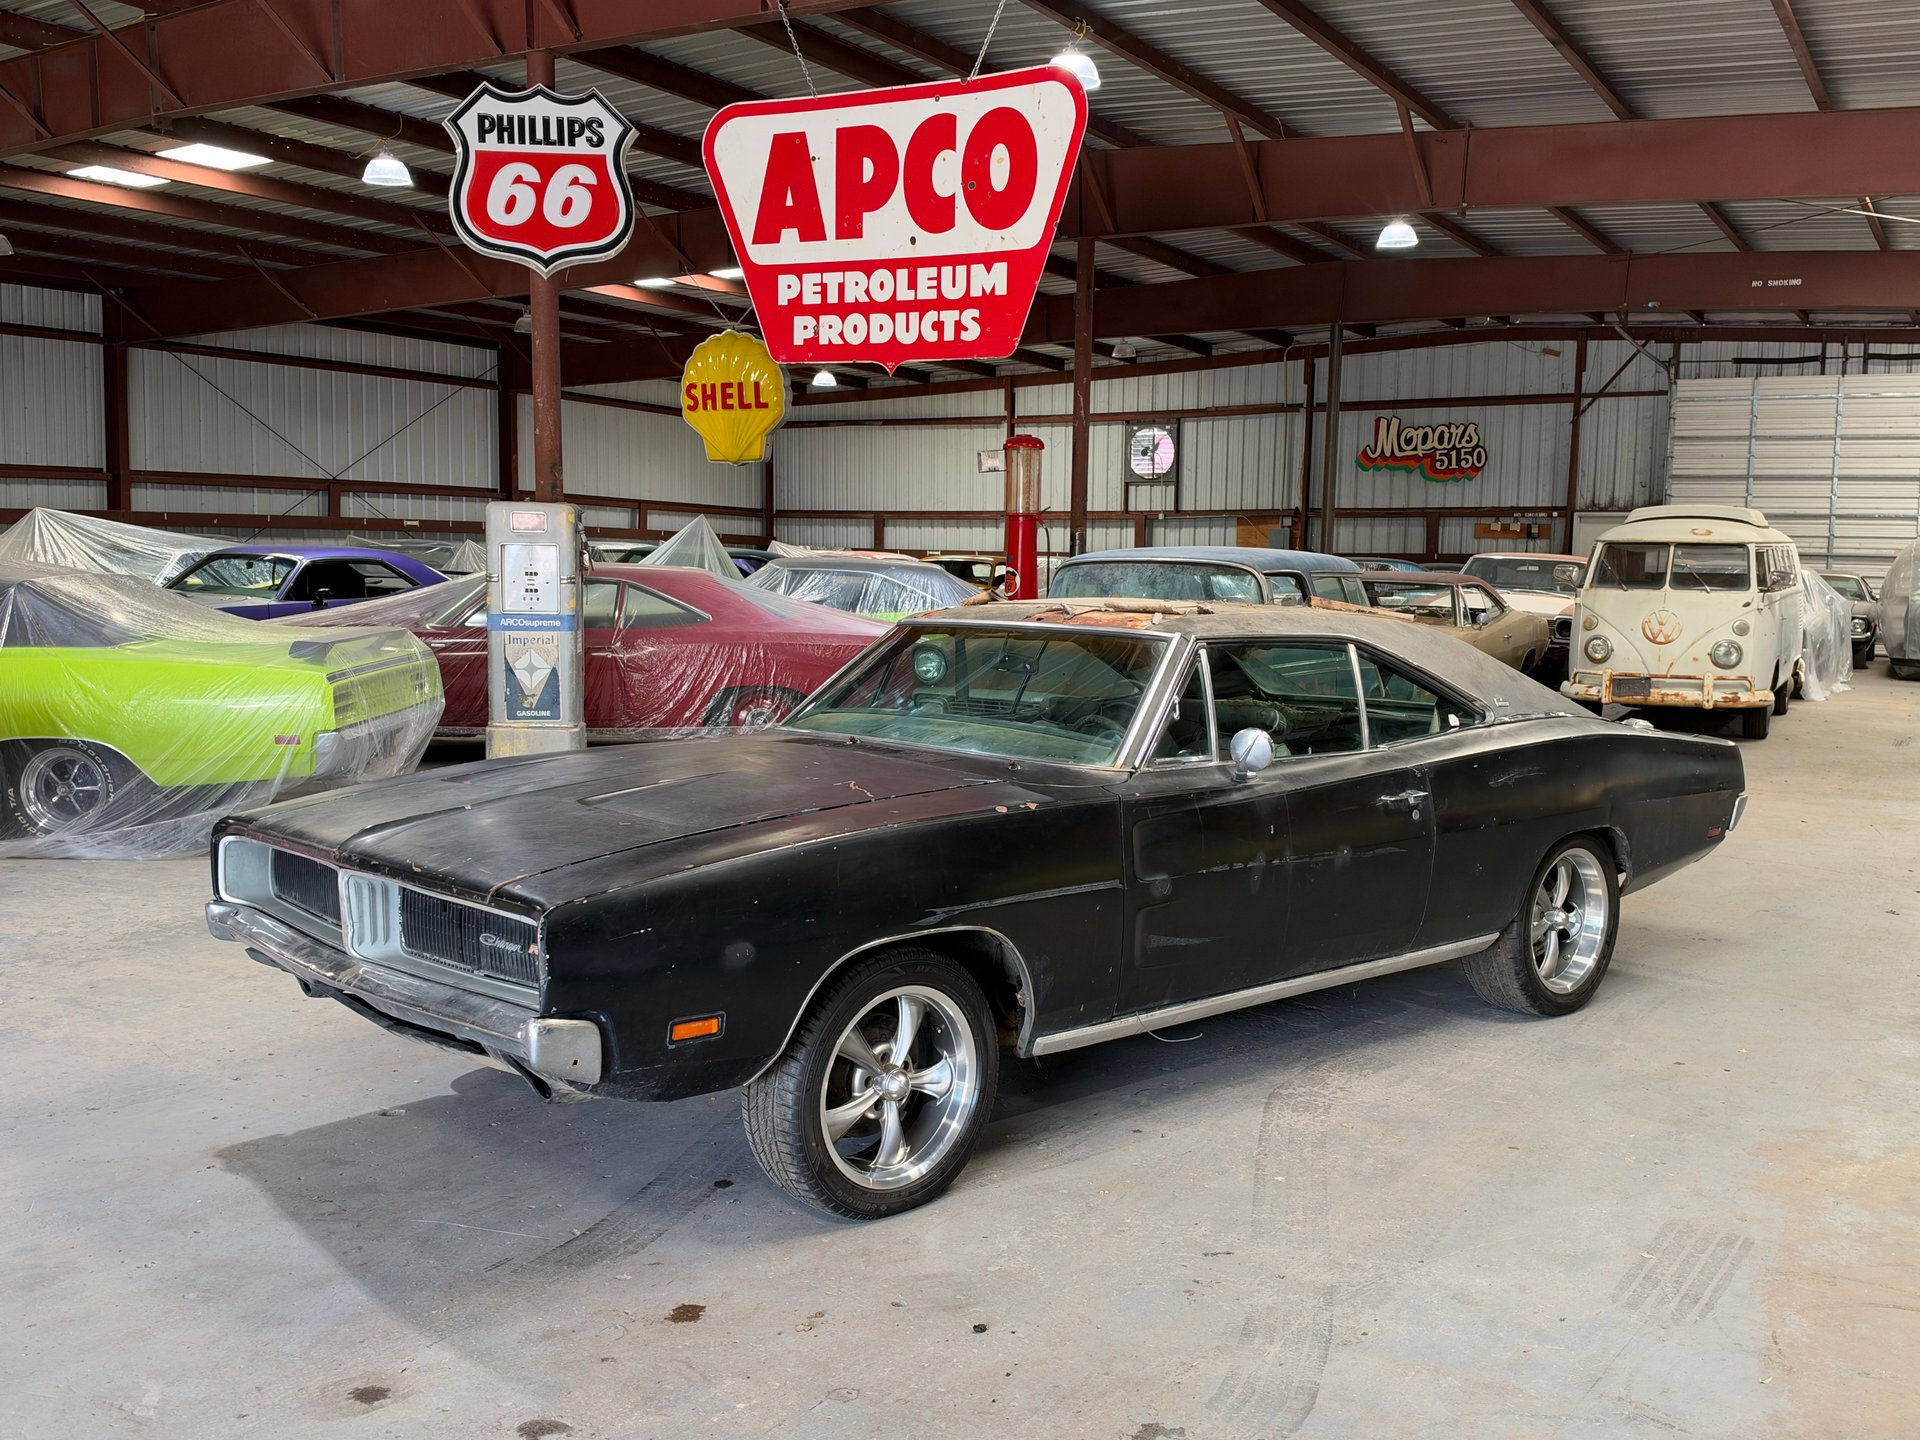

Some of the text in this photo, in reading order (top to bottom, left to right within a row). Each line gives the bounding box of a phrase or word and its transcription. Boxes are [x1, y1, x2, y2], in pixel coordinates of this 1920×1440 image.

[477, 112, 605, 148] PHILLIPS
[751, 106, 1038, 245] APCO
[486, 161, 598, 229] 66
[777, 261, 1008, 306] PETROLEUM
[1751, 278, 1802, 288] NO SMOKING
[793, 308, 981, 346] PRODUCTS
[685, 381, 769, 412] SHELL
[1365, 415, 1480, 458] Mopars
[1435, 447, 1487, 470] 5150
[499, 617, 561, 628] ARCOsupreme
[508, 634, 554, 647] Imperial
[1642, 609, 1683, 645] VW
[479, 933, 524, 954] Charger
